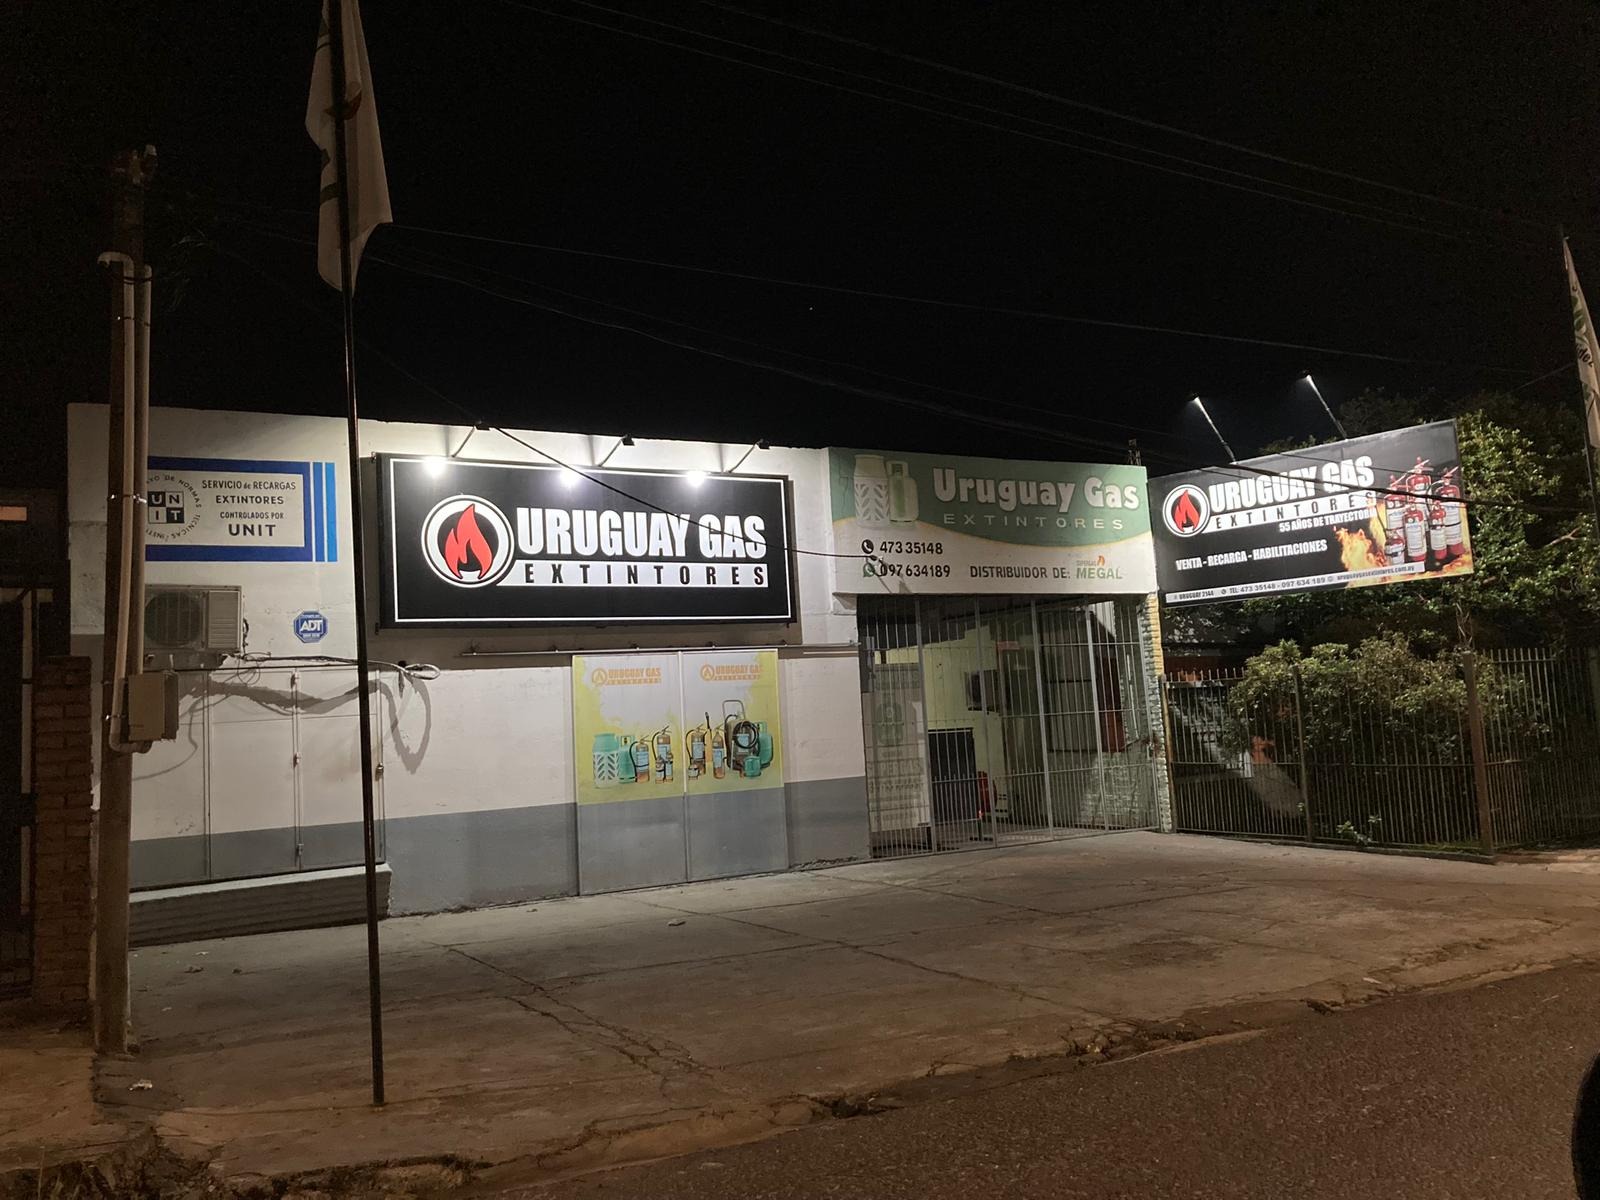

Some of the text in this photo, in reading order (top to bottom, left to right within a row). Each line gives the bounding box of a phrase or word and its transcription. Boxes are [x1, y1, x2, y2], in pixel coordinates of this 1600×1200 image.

[202, 480, 297, 490] SERVICIO de RECARGAS
[932, 467, 1140, 513] Uruguay Gas
[1208, 455, 1376, 514] URUGUAY GAS
[178, 479, 202, 508] NORMAS
[215, 495, 284, 505] EXTINTORES
[220, 511, 269, 520] CONTROLADOS
[1215, 490, 1373, 530] EXTINTORES
[228, 523, 276, 537] UNIT
[943, 513, 1124, 530] EXTINTORES
[1279, 522, 1291, 533] 55
[1291, 518, 1313, 531] AÑOS
[1313, 516, 1325, 528] DE
[516, 507, 767, 559] URUGUAY GAS
[880, 541, 944, 555] 473 35148
[1175, 558, 1202, 571] VENTA
[1208, 551, 1248, 567] RECARGA
[1253, 539, 1328, 561] HABILITACIONES
[525, 563, 765, 585] EXTINTORES
[880, 564, 951, 578] 097 634189
[970, 566, 1123, 580] DISTRIBUIDOR DE: MEGAL
[1179, 591, 1201, 600] URUGUAY
[1240, 585, 1254, 593] 473
[1255, 583, 1276, 592] 35148
[1281, 580, 1295, 588] 097
[1296, 578, 1310, 587] 634
[1312, 576, 1326, 584] 189
[299, 619, 323, 632] ADT
